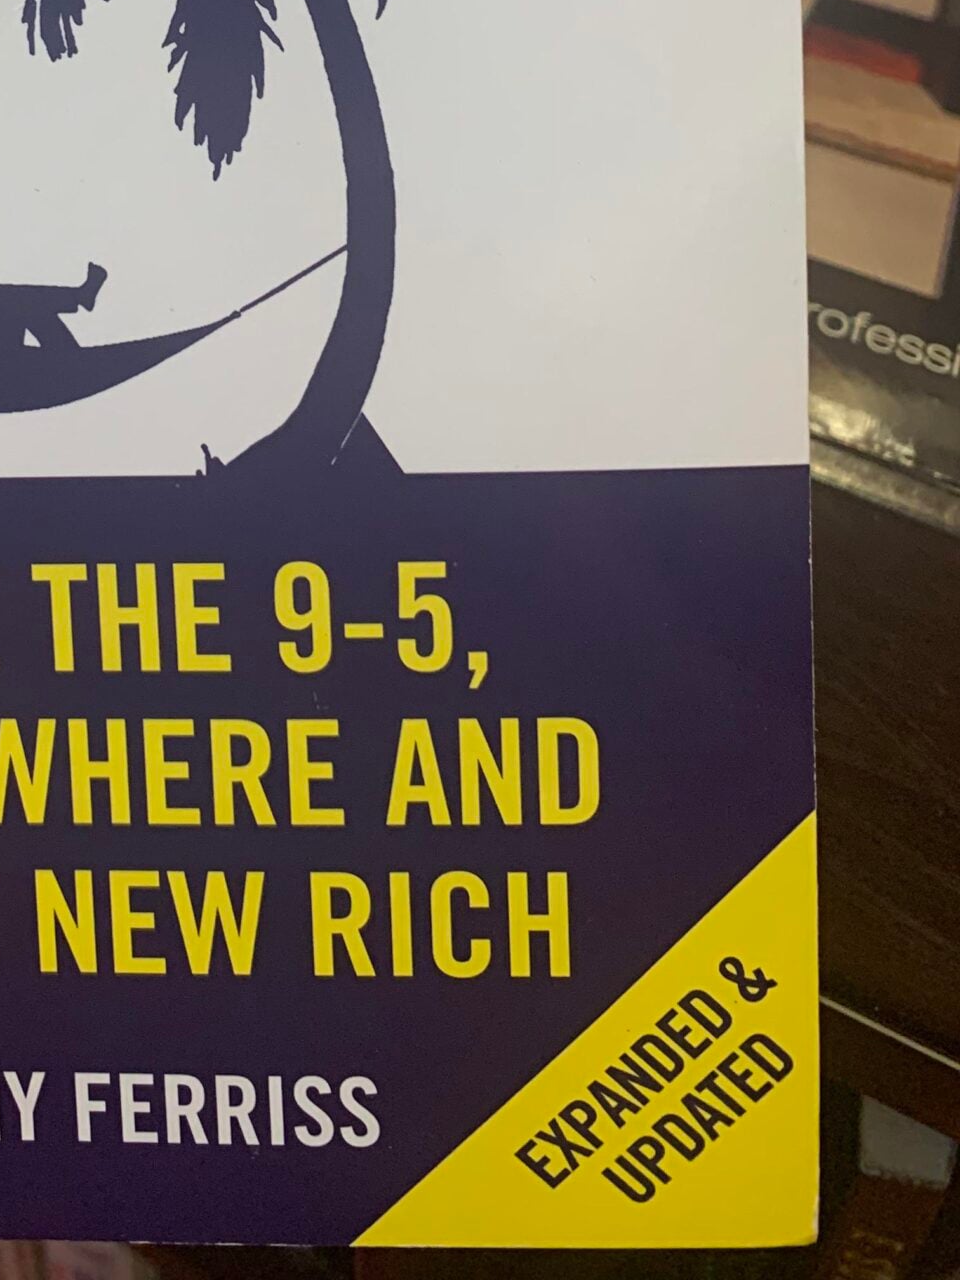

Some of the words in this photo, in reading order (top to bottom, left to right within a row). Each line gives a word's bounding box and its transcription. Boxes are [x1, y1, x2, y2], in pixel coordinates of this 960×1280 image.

[31, 562, 233, 673] THE
[272, 560, 489, 690] 9-5,
[385, 716, 601, 827] AND
[34, 868, 265, 977] NEW
[309, 870, 572, 979] RICH
[73, 1071, 381, 1149] FERRISS
[514, 988, 733, 1190] EXPANDED
[718, 956, 778, 1003] &
[600, 1032, 795, 1204] UPDATED
